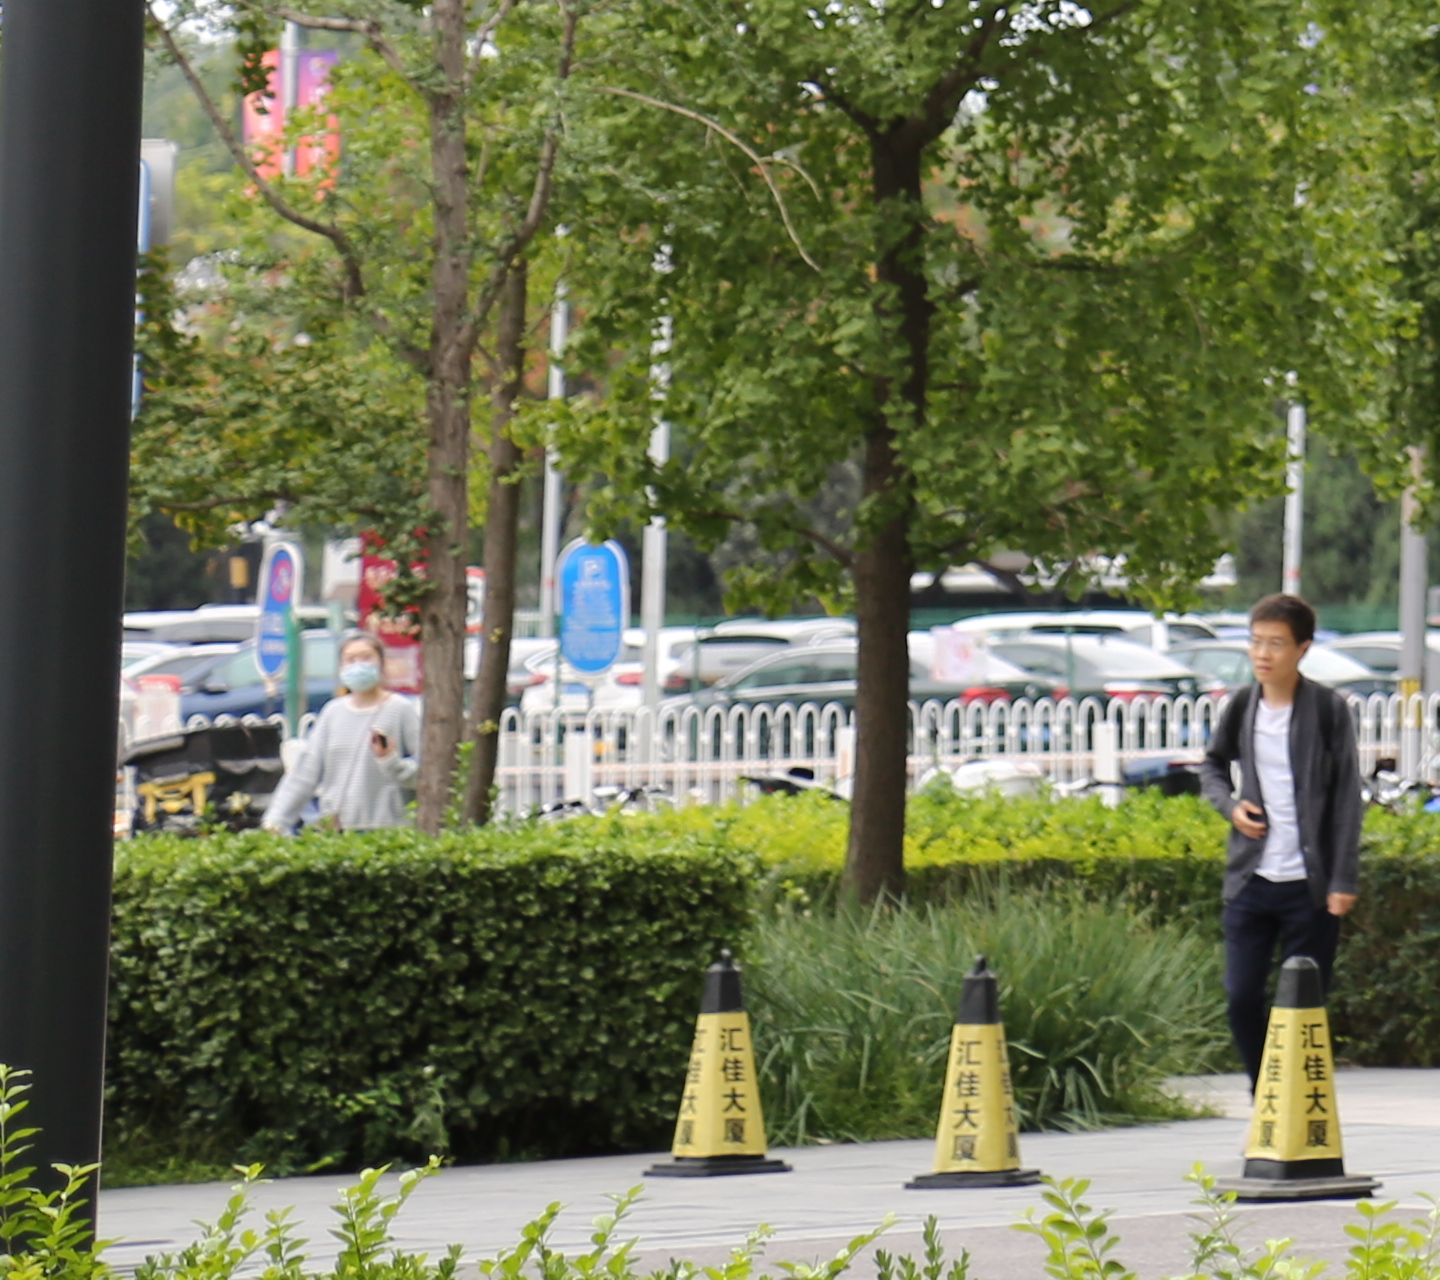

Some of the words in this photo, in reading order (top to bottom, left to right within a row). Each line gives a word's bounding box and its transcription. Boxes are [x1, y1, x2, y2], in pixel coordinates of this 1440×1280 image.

[719, 1026, 747, 1145] 汇佳大厦
[950, 1039, 982, 1162] 汇佳大厦
[1300, 1022, 1329, 1148] 汇佳大厦
